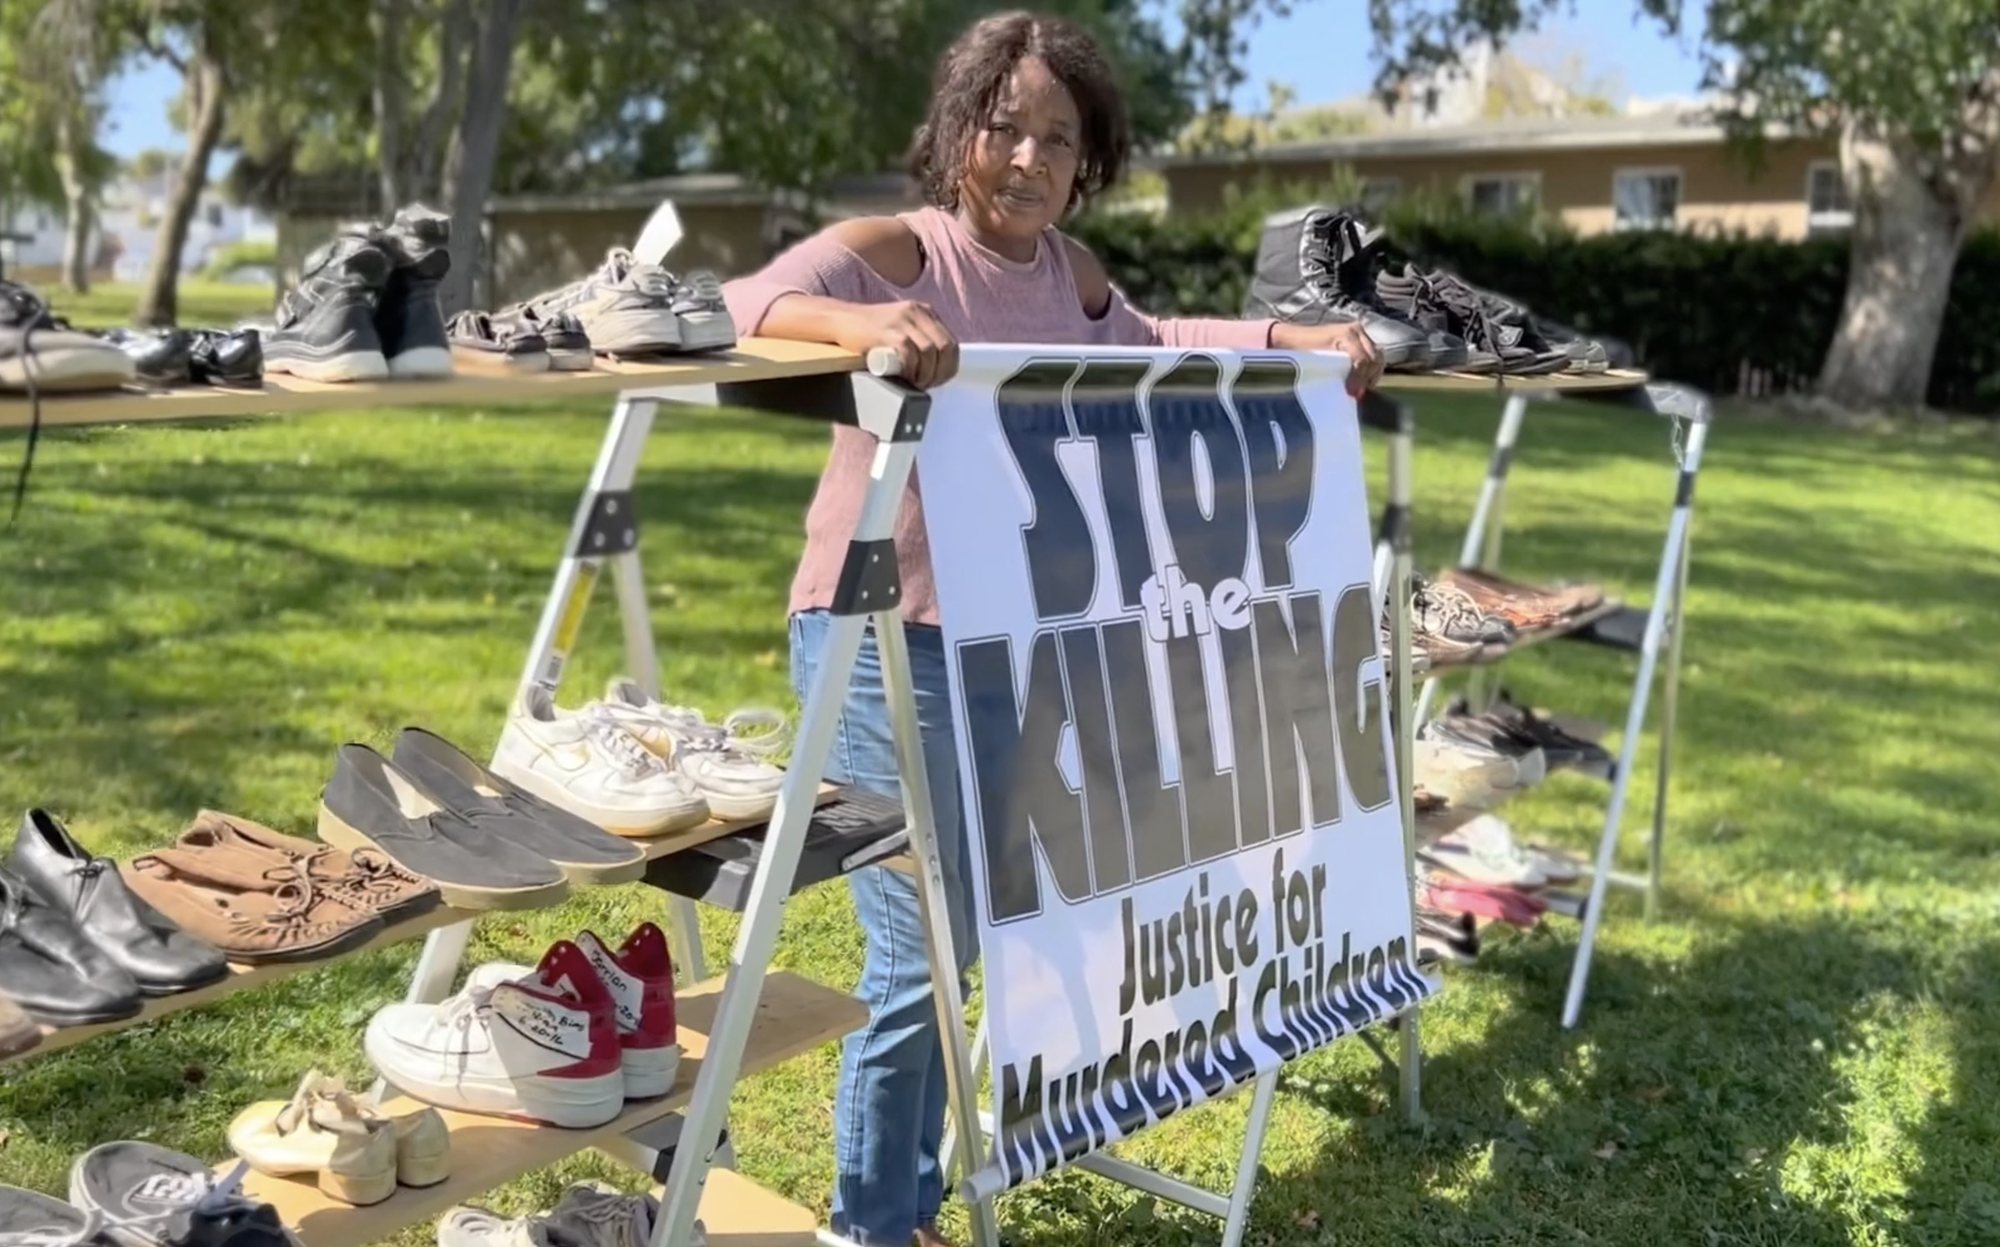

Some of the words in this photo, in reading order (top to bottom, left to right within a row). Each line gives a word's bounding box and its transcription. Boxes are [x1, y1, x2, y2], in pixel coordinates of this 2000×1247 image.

[994, 352, 1316, 623] STOP
[1140, 564, 1252, 642] the
[955, 583, 1394, 926] KILLING
[1120, 872, 1258, 1015] Justice
[1272, 847, 1326, 954] for
[1002, 976, 1256, 1188] Murdered
[1253, 932, 1428, 1061] Children
